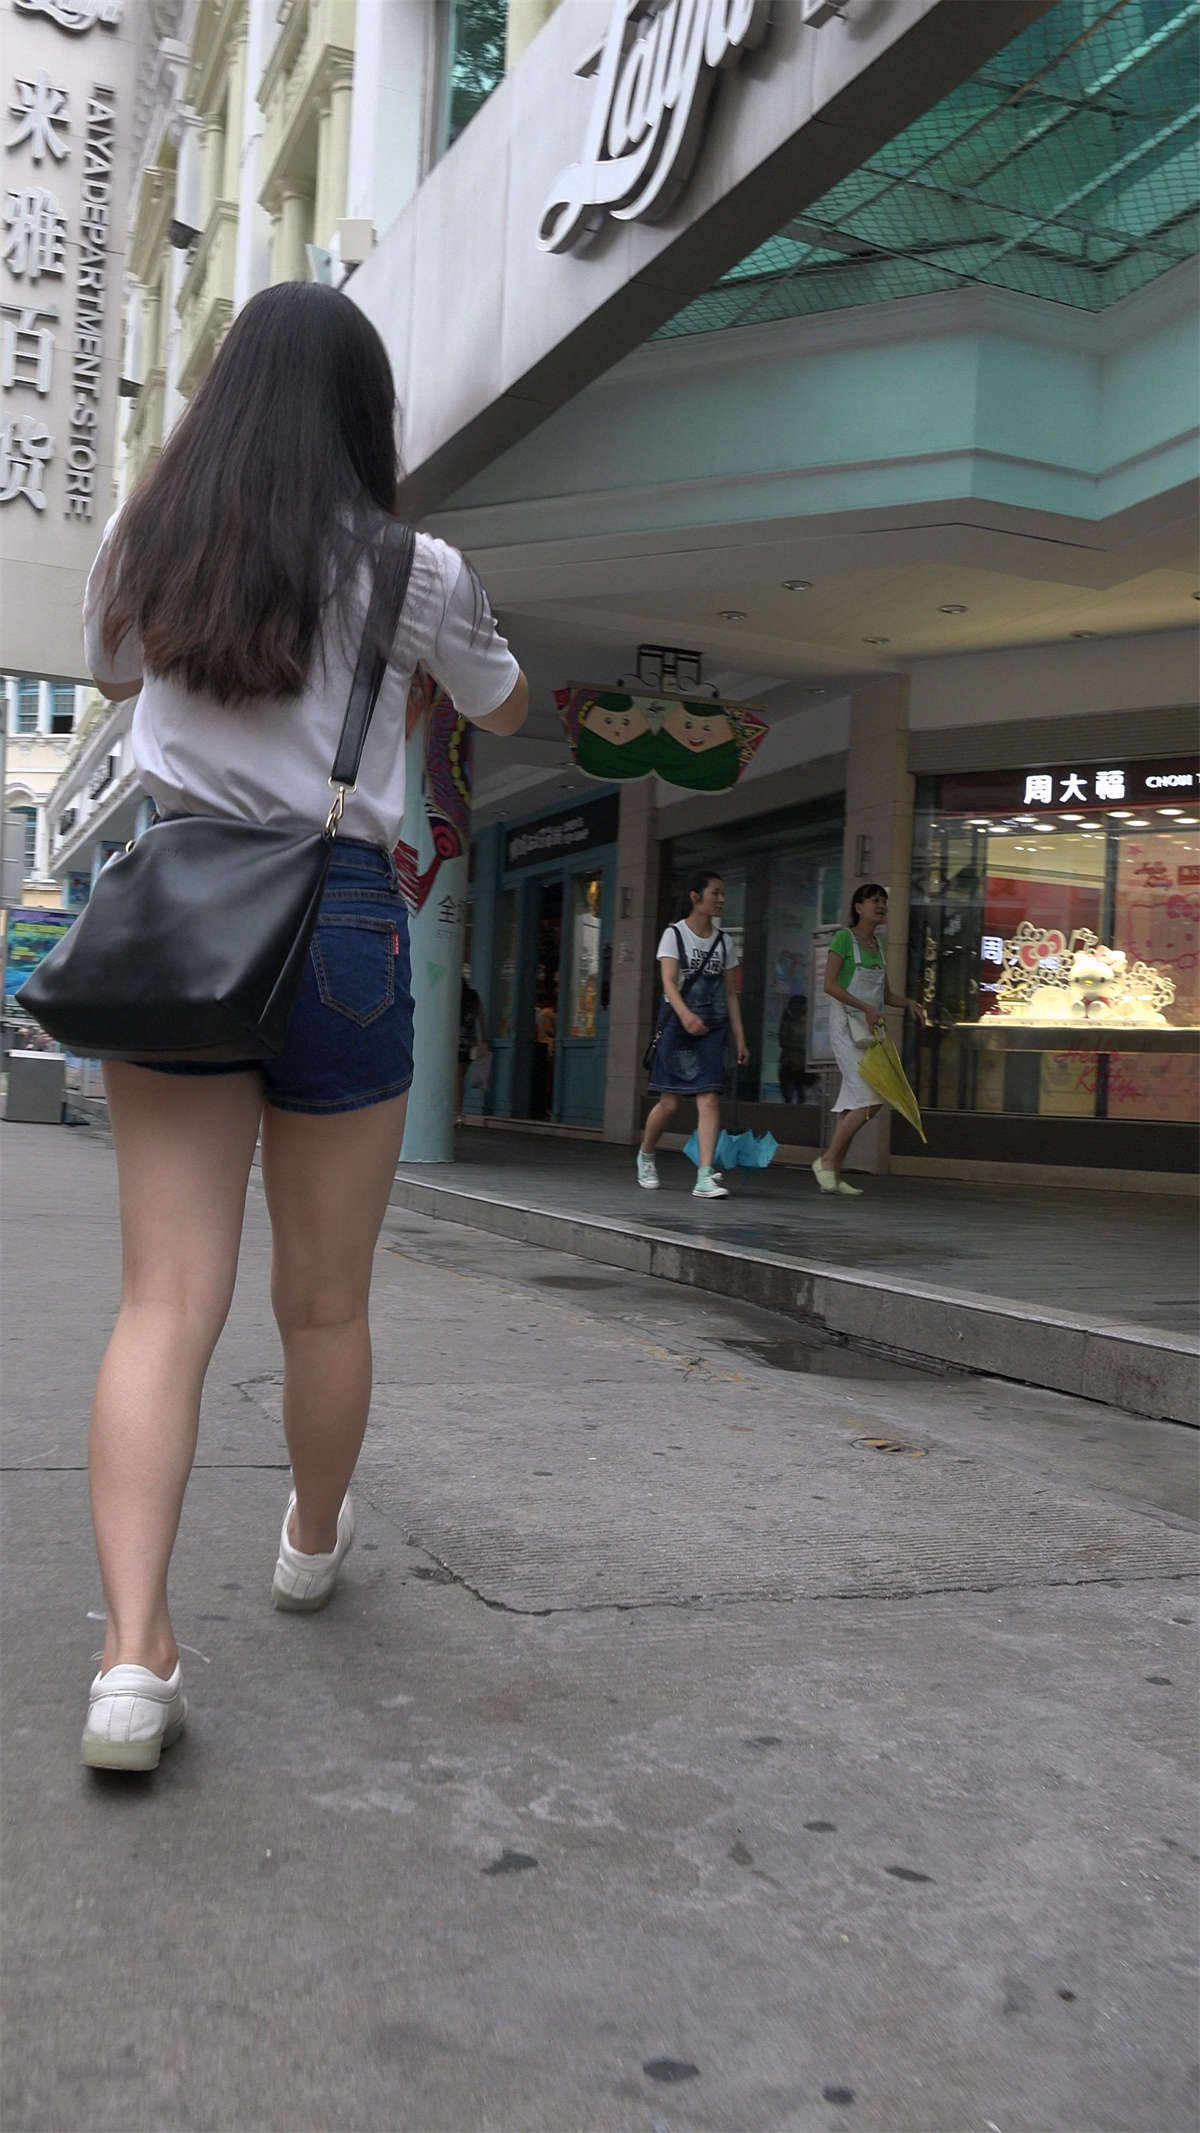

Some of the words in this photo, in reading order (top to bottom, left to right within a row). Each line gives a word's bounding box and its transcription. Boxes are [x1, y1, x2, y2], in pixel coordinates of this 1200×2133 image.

[0, 69, 72, 510] 来雅百货
[1023, 770, 1126, 804] 周大福
[1145, 774, 1193, 788] CHOW
